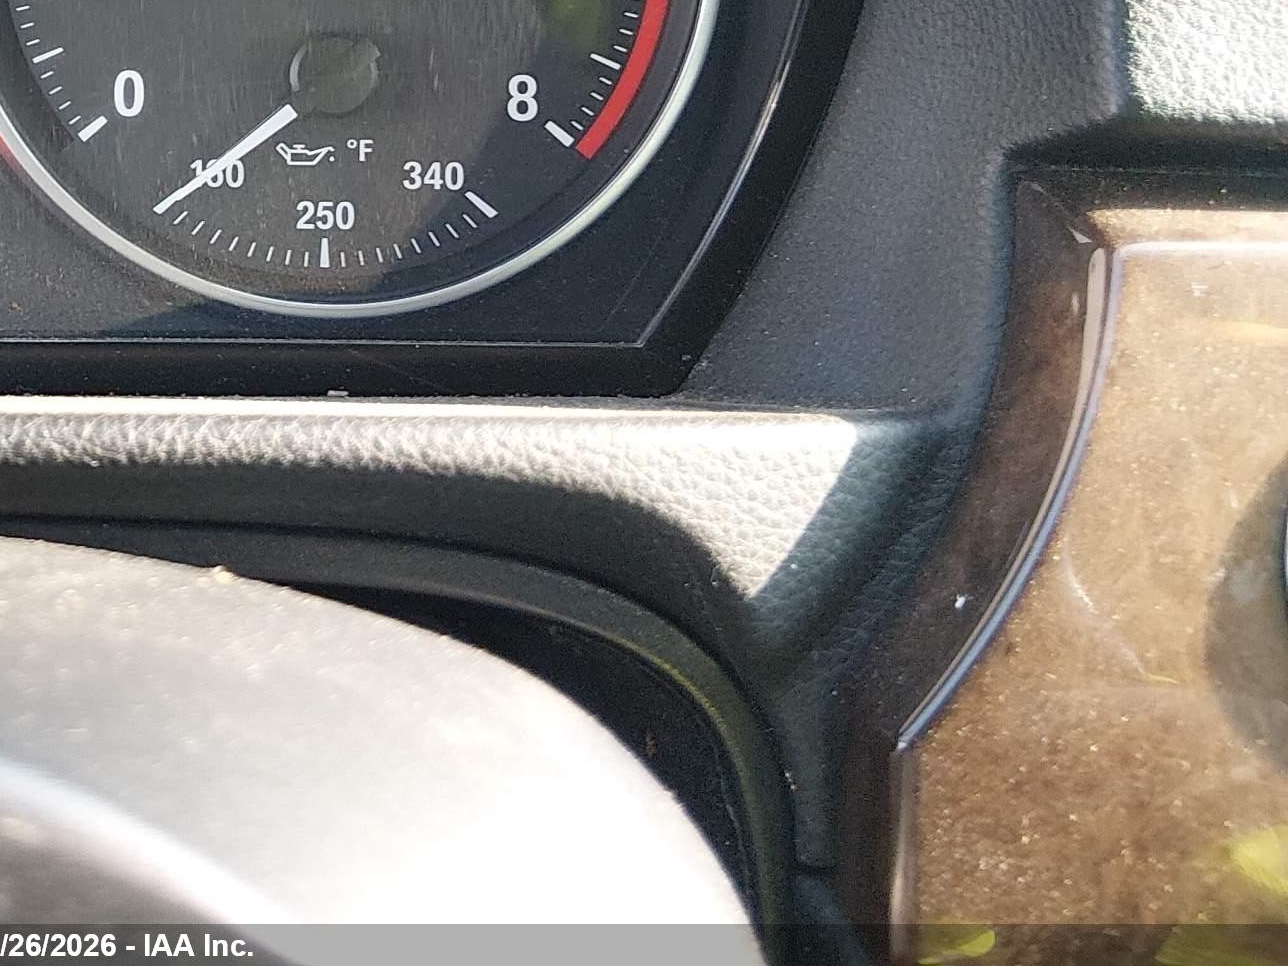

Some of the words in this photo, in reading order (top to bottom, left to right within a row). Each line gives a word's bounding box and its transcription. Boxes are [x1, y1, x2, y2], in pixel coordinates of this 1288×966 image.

[114, 70, 145, 117] 0
[507, 74, 539, 121] 8
[403, 162, 465, 190] 340
[295, 200, 356, 230] 250
